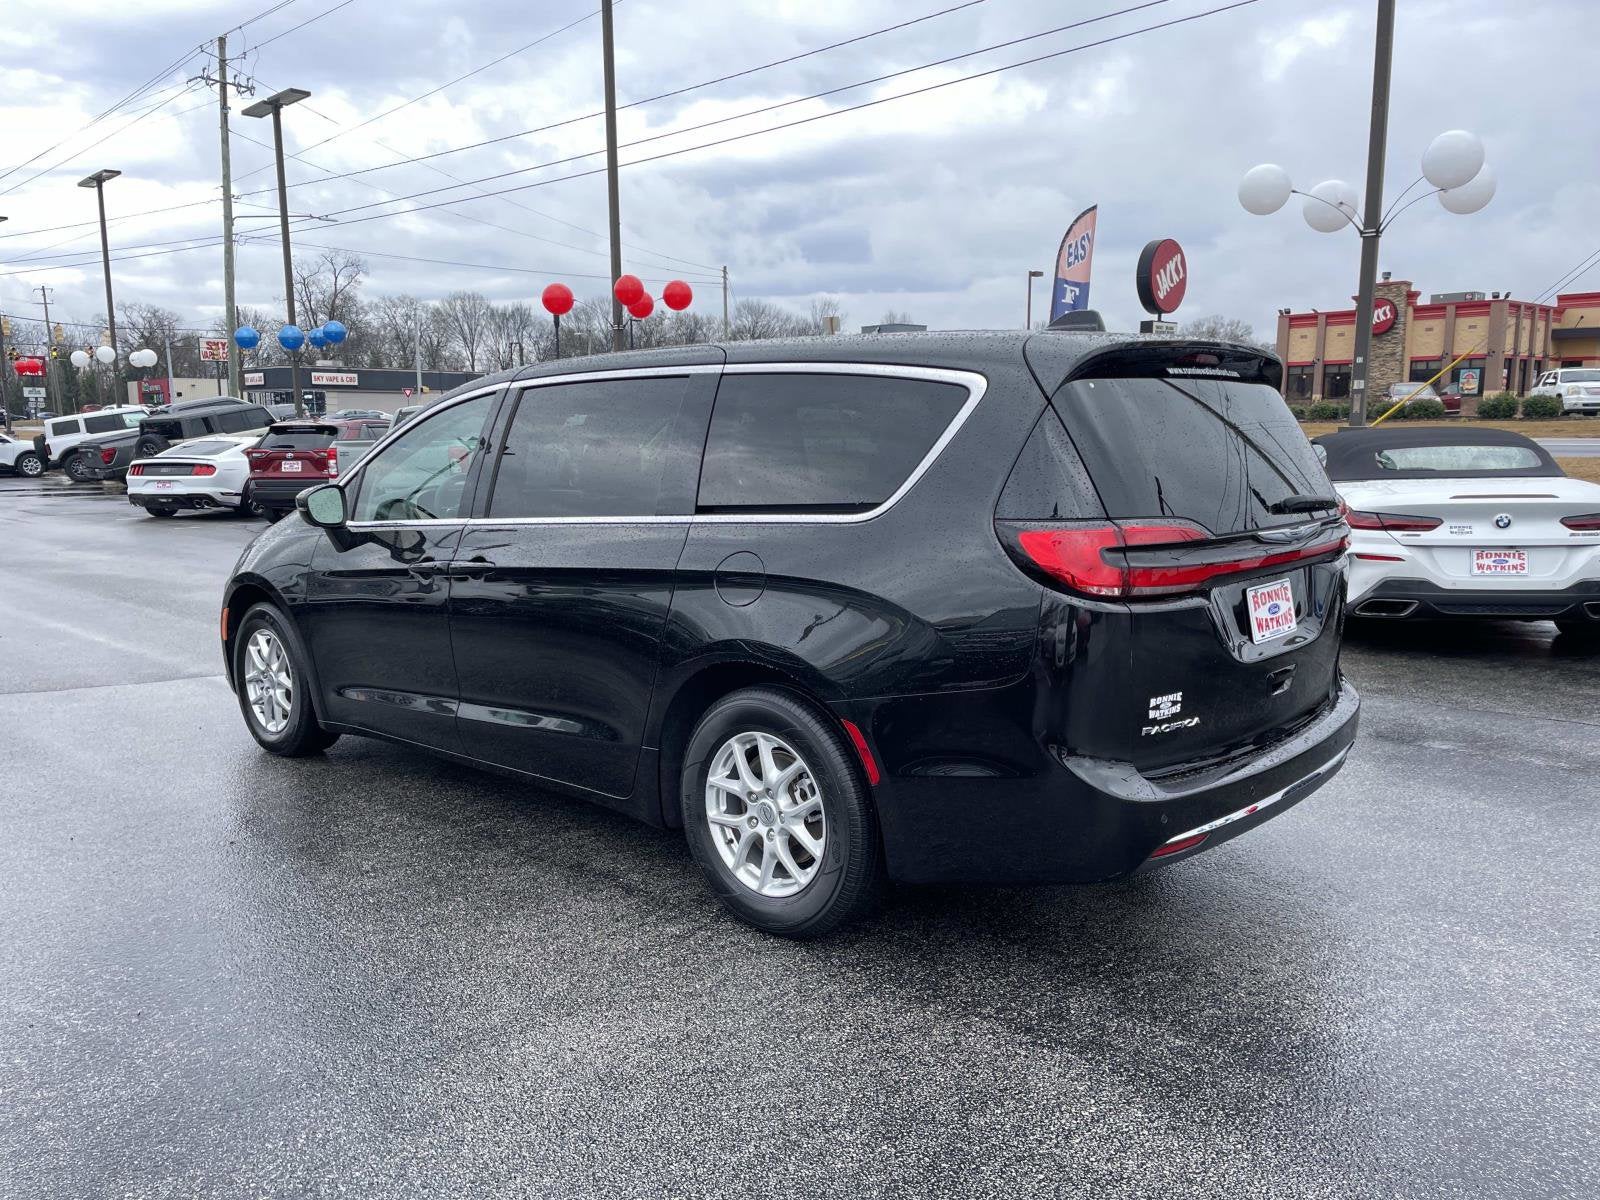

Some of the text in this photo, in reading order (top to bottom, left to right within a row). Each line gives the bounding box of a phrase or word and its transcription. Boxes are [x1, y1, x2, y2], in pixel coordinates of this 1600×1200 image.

[313, 375, 324, 383] SKY
[325, 375, 339, 383] VAPE
[1476, 552, 1526, 561] RONNIE
[1476, 562, 1526, 571] WATKINS
[1251, 586, 1290, 612] RONNIE
[1255, 606, 1293, 634] WATKINS
[1149, 691, 1183, 708] RONNIE
[1148, 702, 1182, 719] WATKINS
[1141, 716, 1201, 737] PACIFICA
